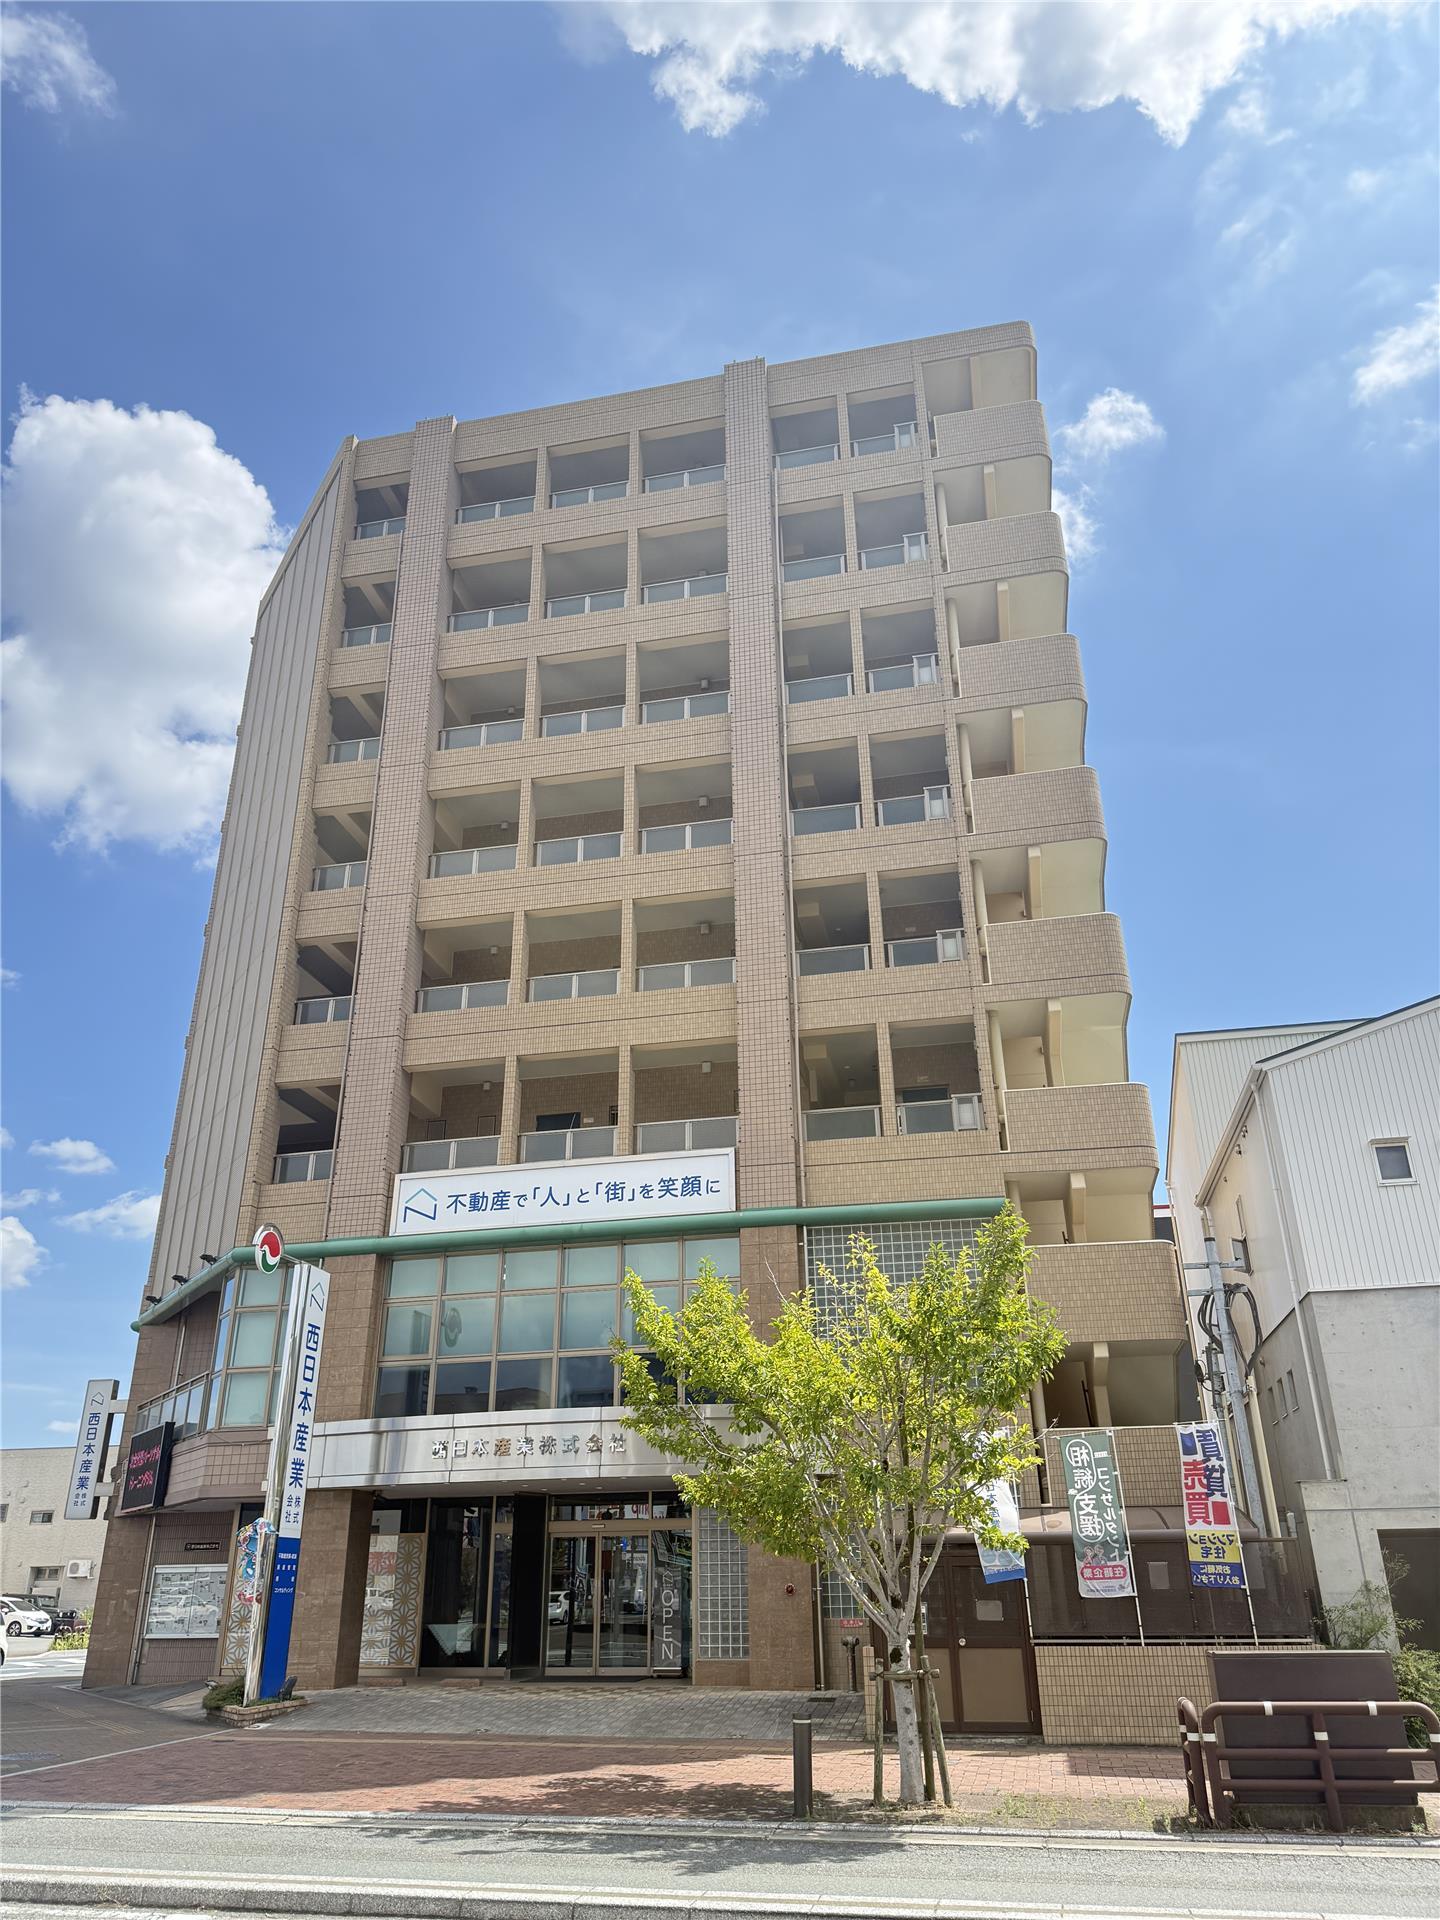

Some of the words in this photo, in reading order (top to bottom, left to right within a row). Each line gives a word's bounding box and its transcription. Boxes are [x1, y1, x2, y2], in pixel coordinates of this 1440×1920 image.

[446, 1175, 721, 1214] 不動産で「人」と「街」を笑顔に
[288, 1322, 321, 1488] 西日本産業
[76, 1412, 102, 1490] 西日本産業
[431, 1433, 627, 1459] 西日本産業株式会社
[661, 1590, 674, 1660] OPEN
